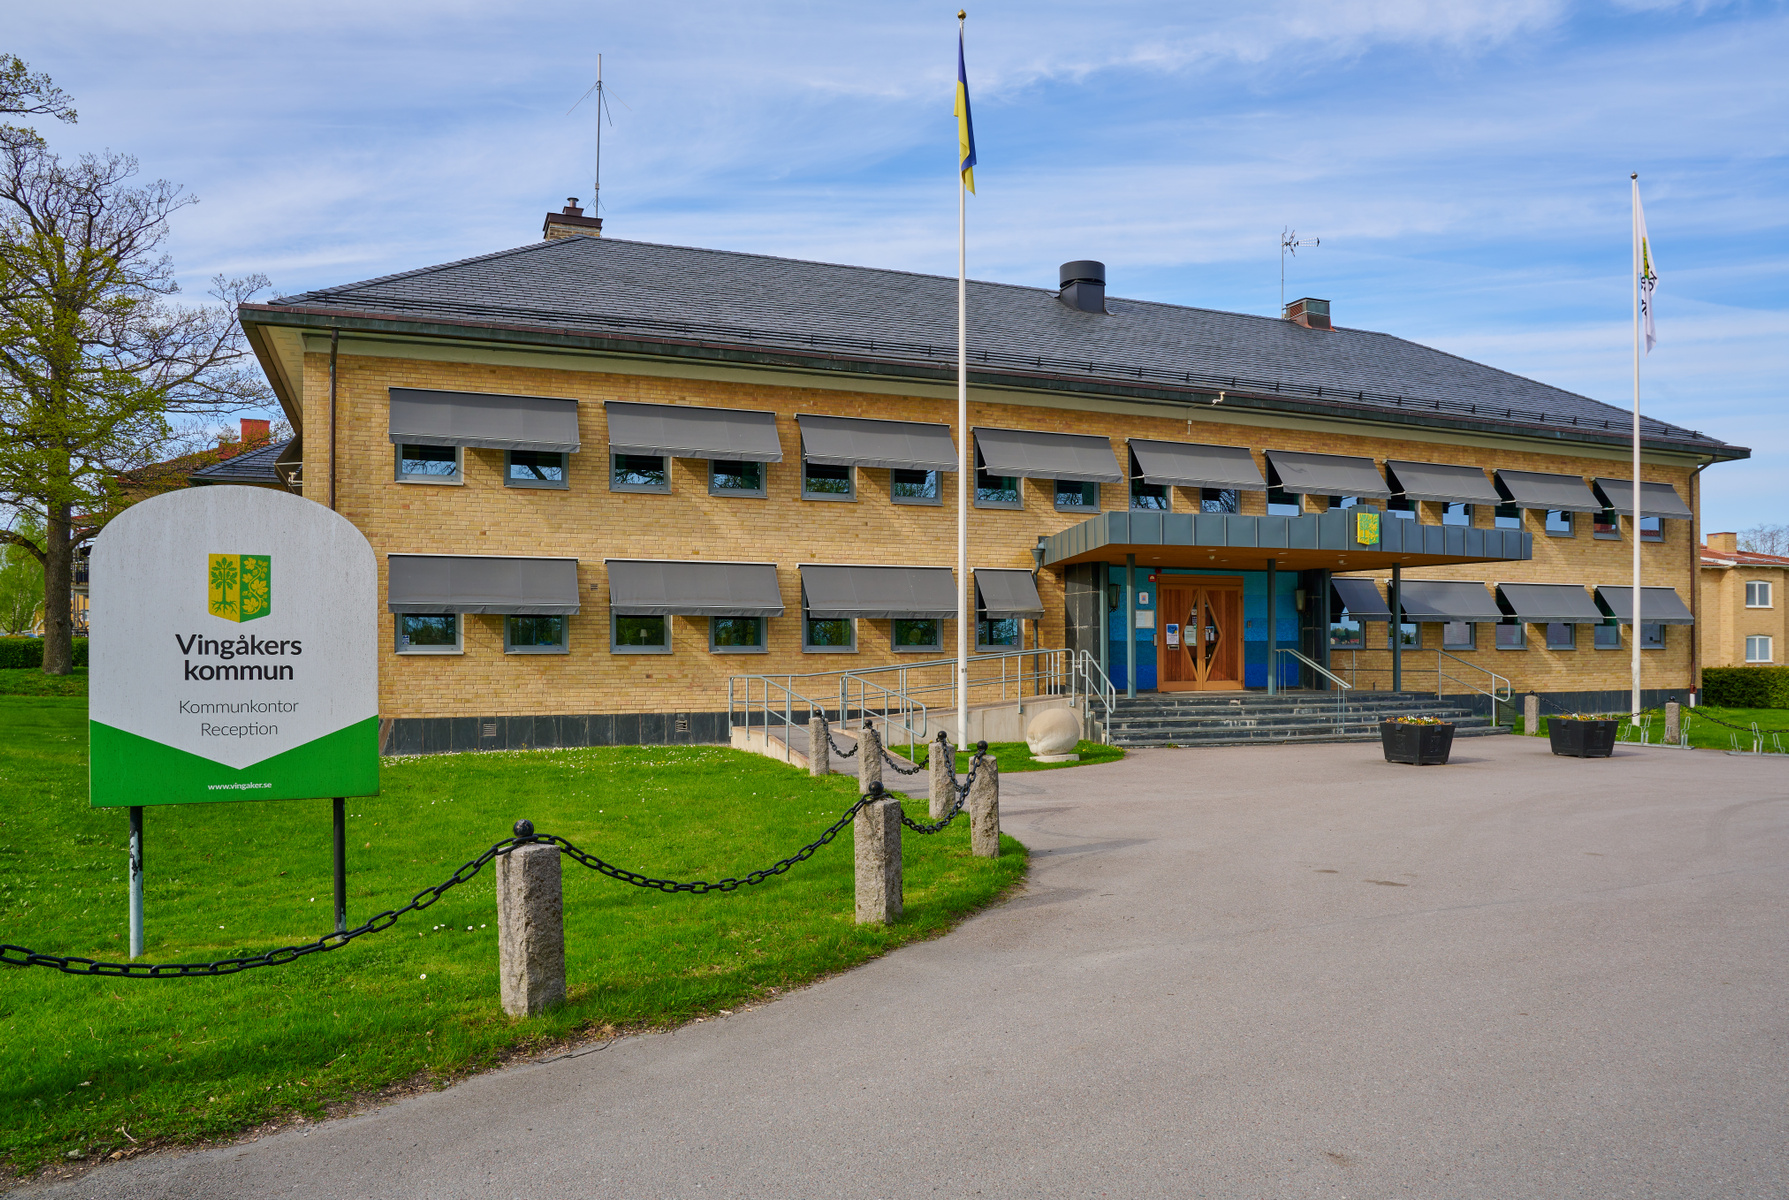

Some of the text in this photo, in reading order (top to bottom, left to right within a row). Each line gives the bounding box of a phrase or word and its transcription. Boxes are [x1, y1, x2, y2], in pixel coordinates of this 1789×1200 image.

[174, 633, 303, 660] Vingåkers
[184, 659, 294, 681] kommun
[179, 699, 299, 714] Kommunkontor
[201, 721, 278, 738] Reception
[207, 781, 272, 791] www.vingaker.se
